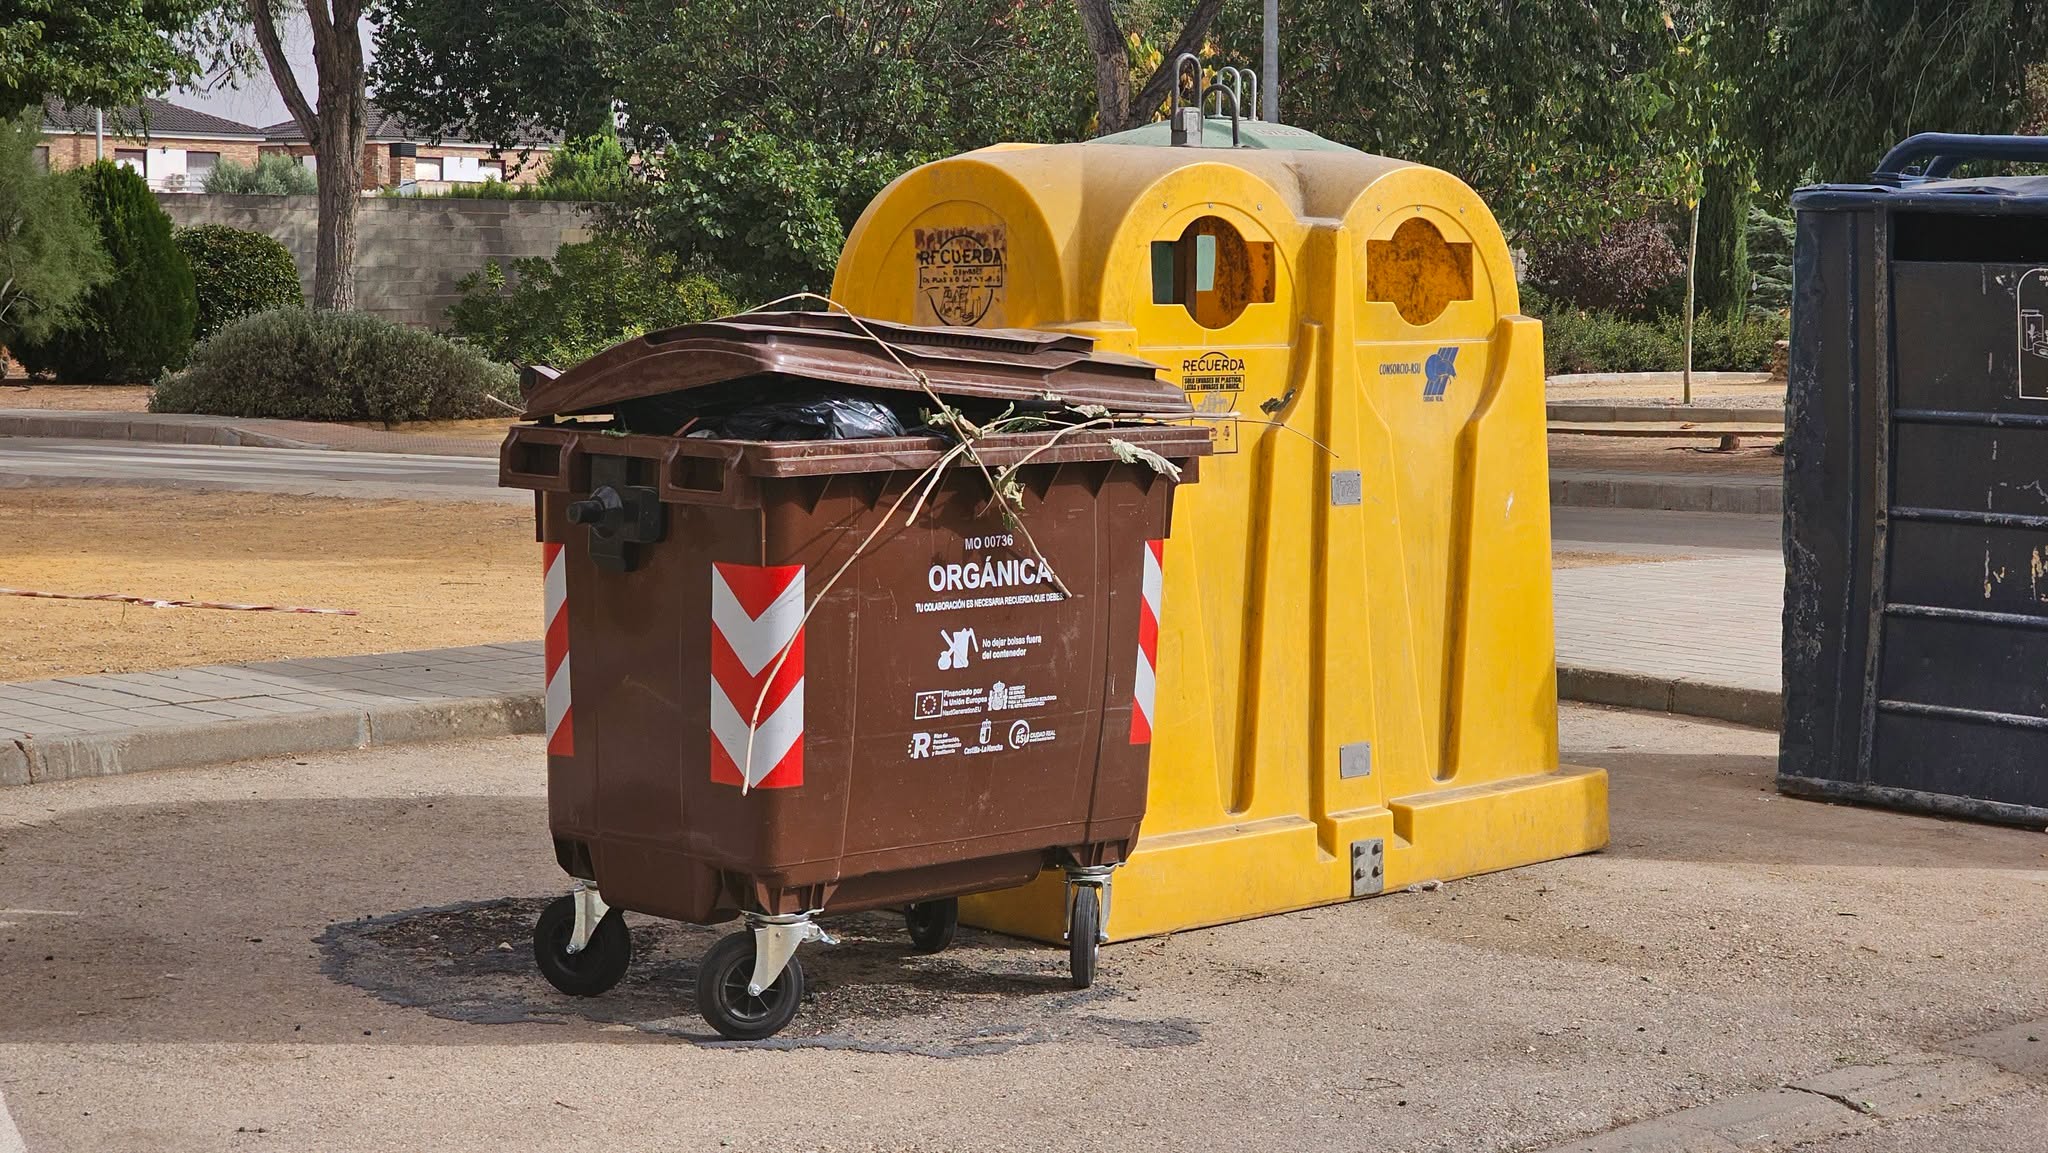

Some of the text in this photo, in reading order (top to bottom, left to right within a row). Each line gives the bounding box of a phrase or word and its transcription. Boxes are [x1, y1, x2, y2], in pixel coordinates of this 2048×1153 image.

[920, 248, 1002, 265] RECUERDA
[1182, 359, 1245, 372] RECUERDA
[1379, 363, 1421, 375] CONSORCIO-RSU
[965, 534, 1014, 550] MO 00736
[928, 556, 1053, 592] ORGÁNICA
[915, 603, 924, 613] TU
[924, 599, 966, 612] COLABORACIÓN
[966, 599, 974, 608] ES
[974, 597, 1004, 608] NECESARIA
[1005, 595, 1034, 605] RECUERDA
[1034, 594, 1046, 603] QUE
[982, 634, 1041, 648] No dejar bolsas fuera
[982, 648, 1026, 660] del contenedor
[944, 687, 983, 698] Financiado por
[949, 698, 965, 706] Unión
[966, 696, 987, 705] Europea
